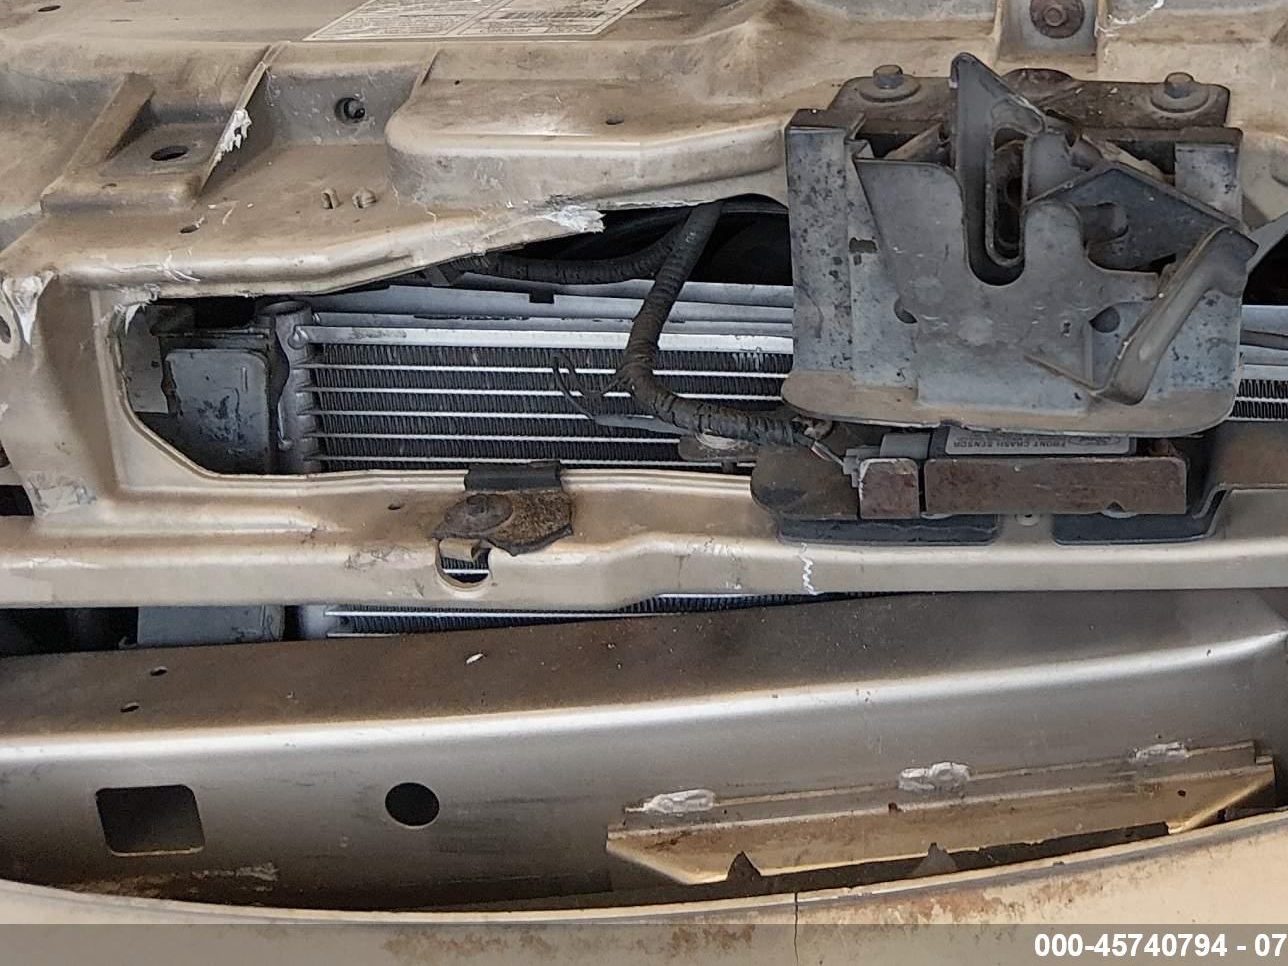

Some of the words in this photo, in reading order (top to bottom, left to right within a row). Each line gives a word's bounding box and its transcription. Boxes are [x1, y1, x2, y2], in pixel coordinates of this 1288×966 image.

[953, 440, 993, 449] SENSOR
[996, 440, 1030, 449] CRASH
[1033, 440, 1066, 449] FRONT
